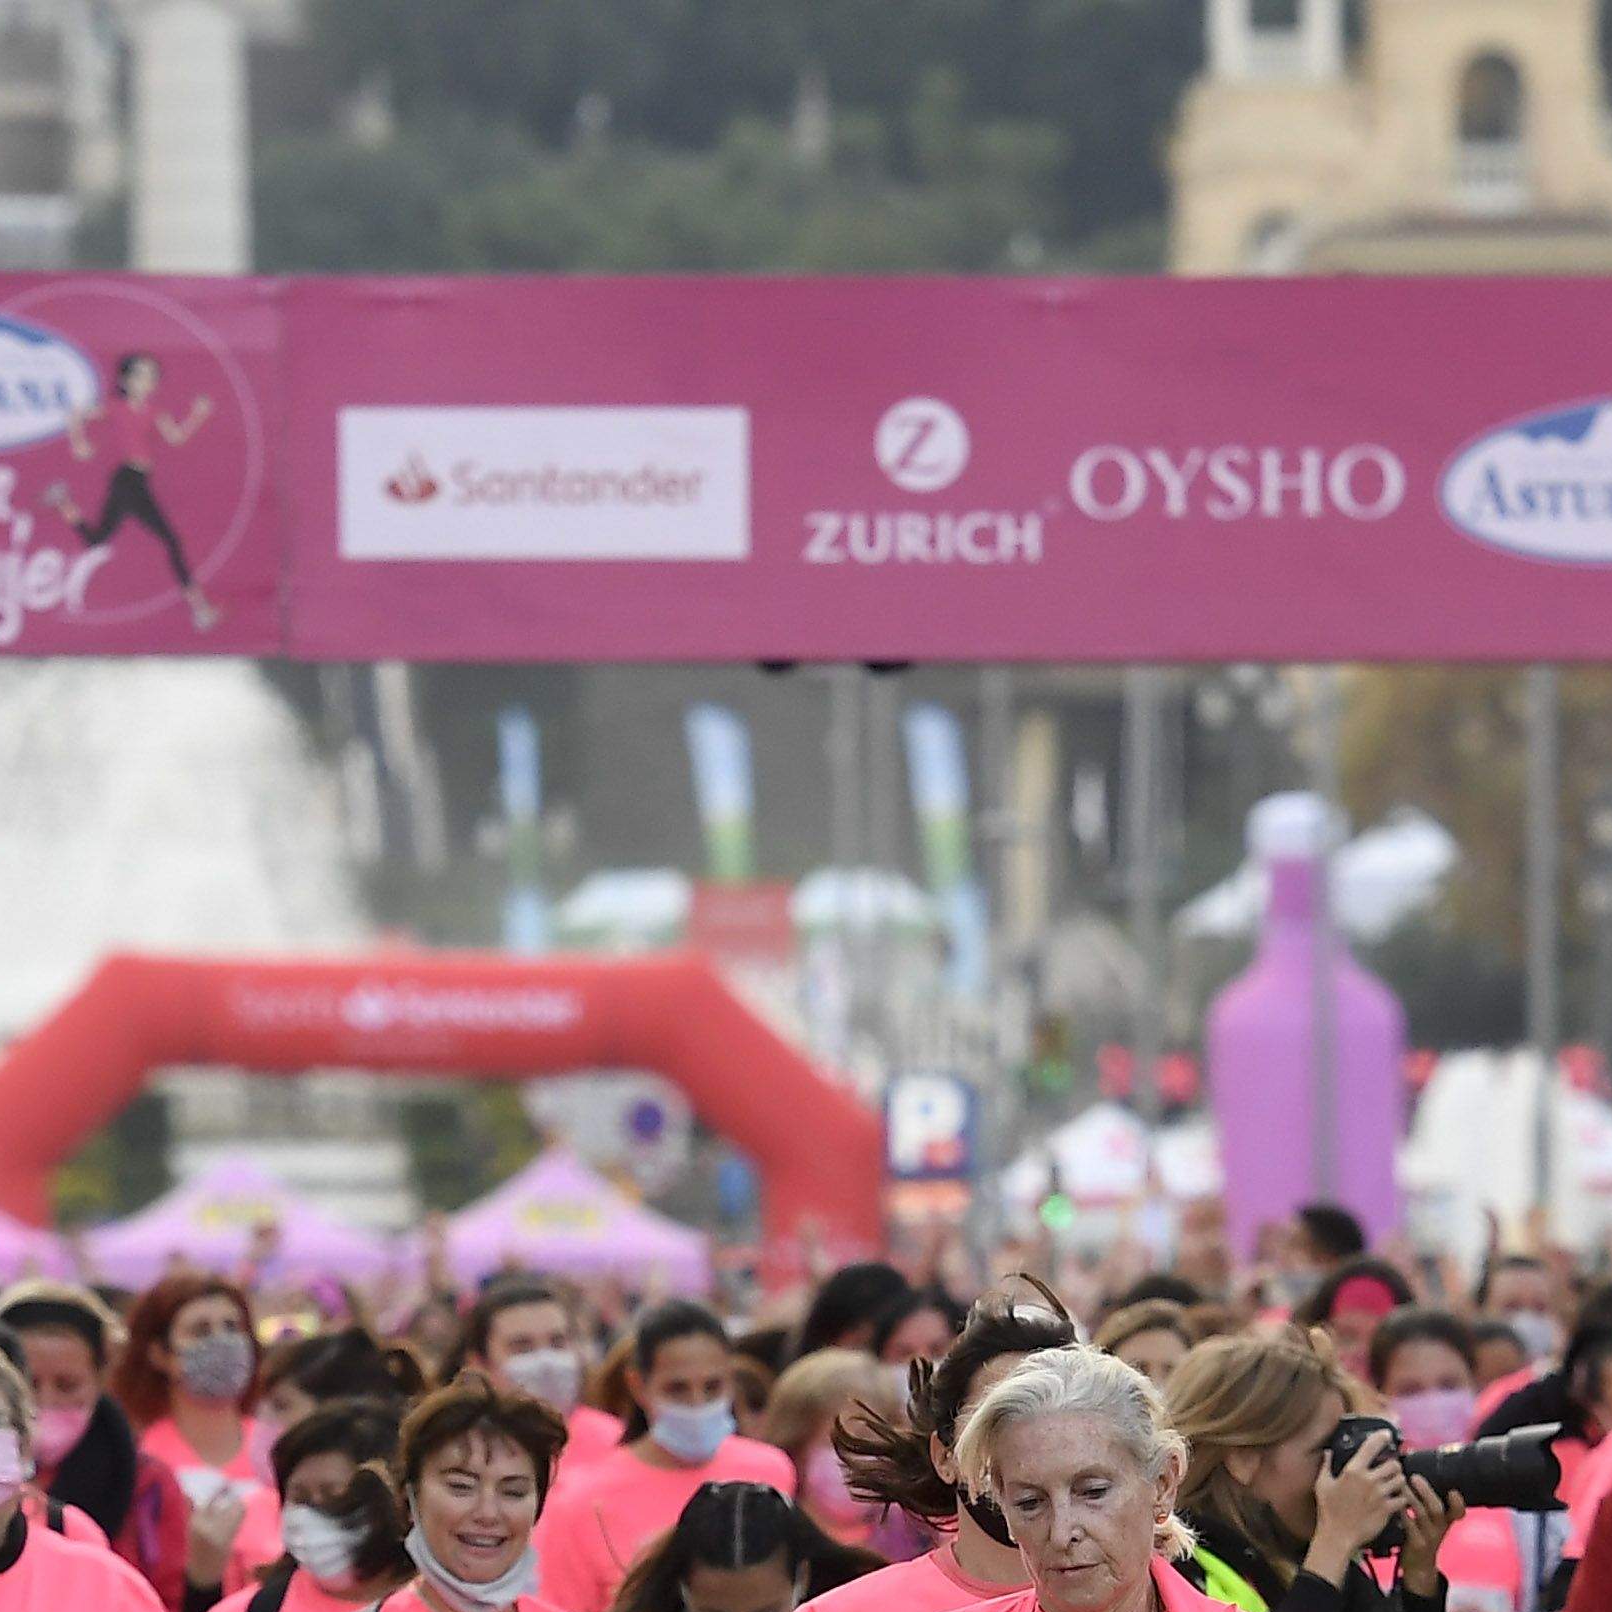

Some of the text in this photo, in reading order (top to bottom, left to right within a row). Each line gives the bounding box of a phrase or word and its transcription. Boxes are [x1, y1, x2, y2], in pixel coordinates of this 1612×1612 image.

[451, 459, 703, 507] Santander
[1071, 443, 1407, 521] OYSHO
[804, 510, 1043, 564] ZURICH
